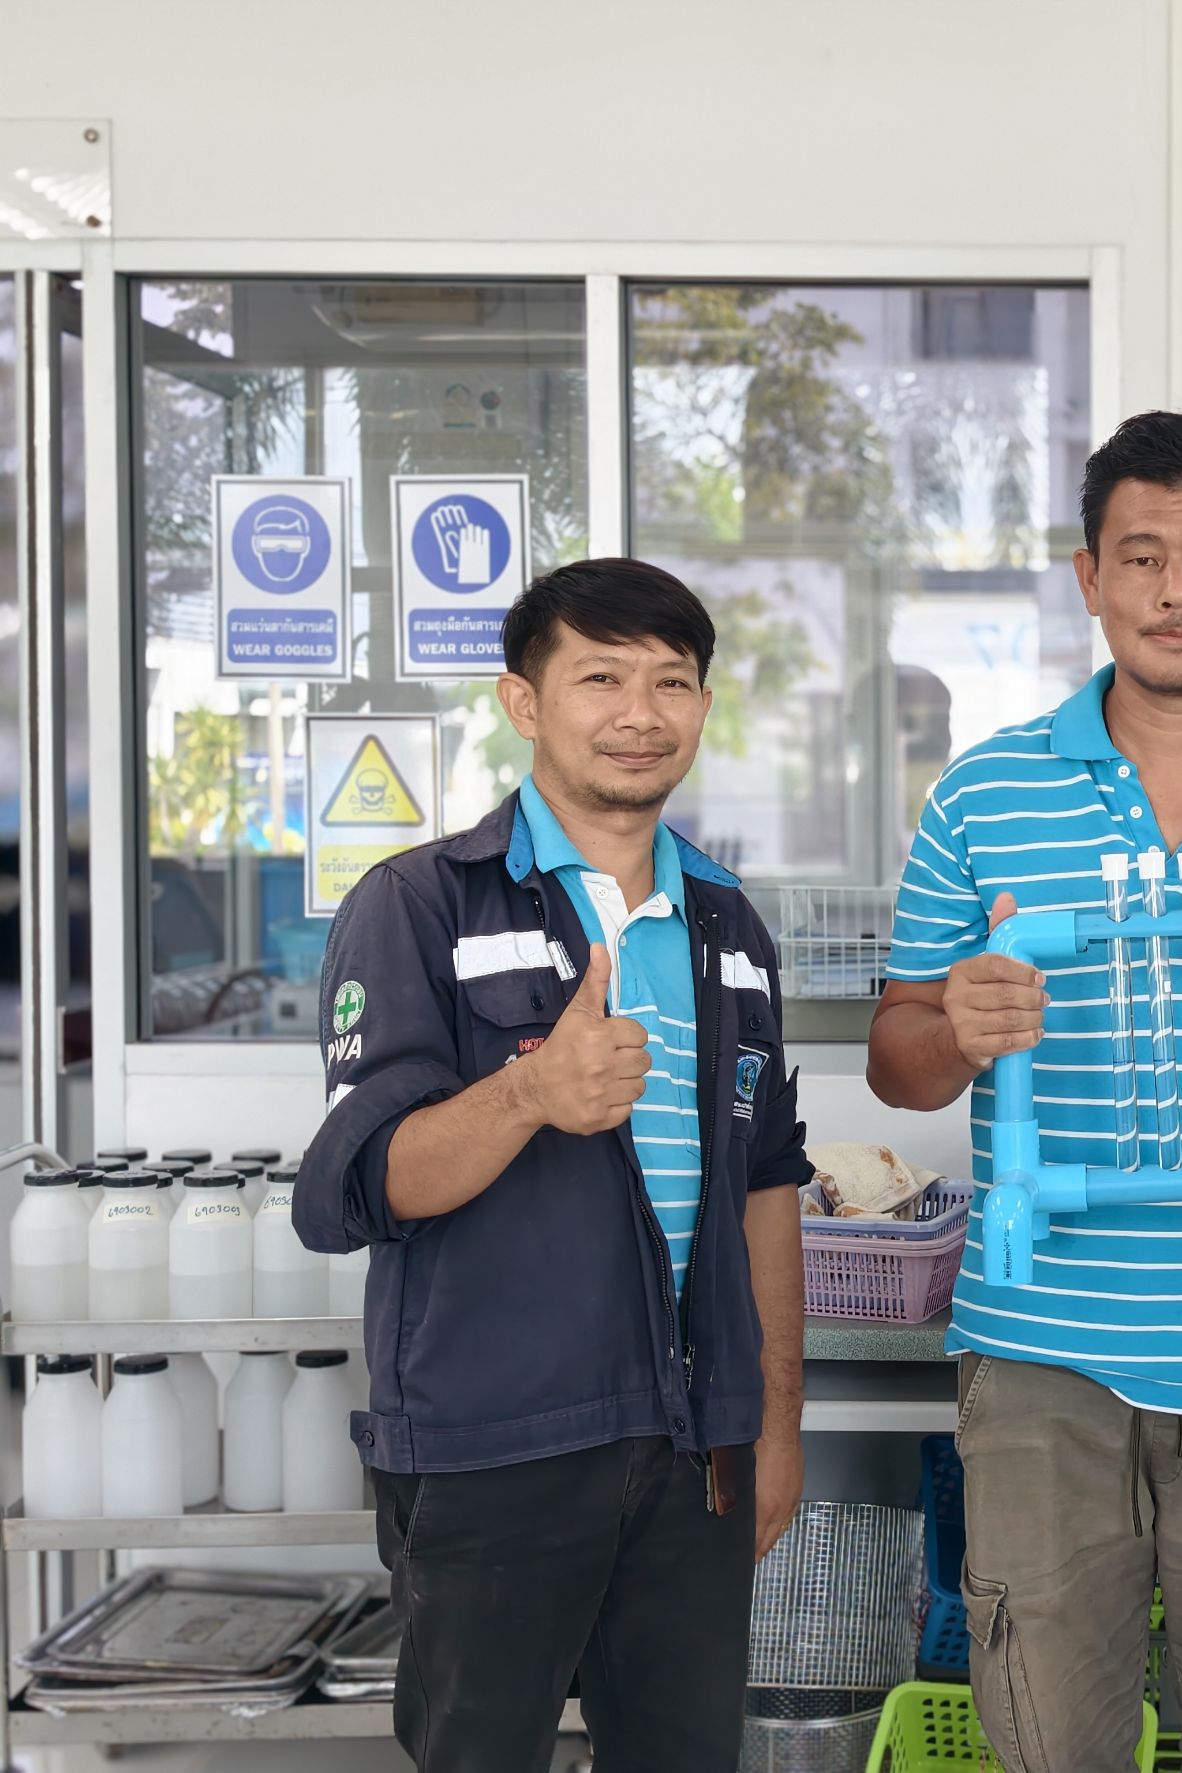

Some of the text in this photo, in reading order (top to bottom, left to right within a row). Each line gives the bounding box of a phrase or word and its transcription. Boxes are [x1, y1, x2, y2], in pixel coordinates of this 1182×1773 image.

[232, 643, 333, 657] WEAR GOGGLES
[417, 643, 456, 655] WEAR
